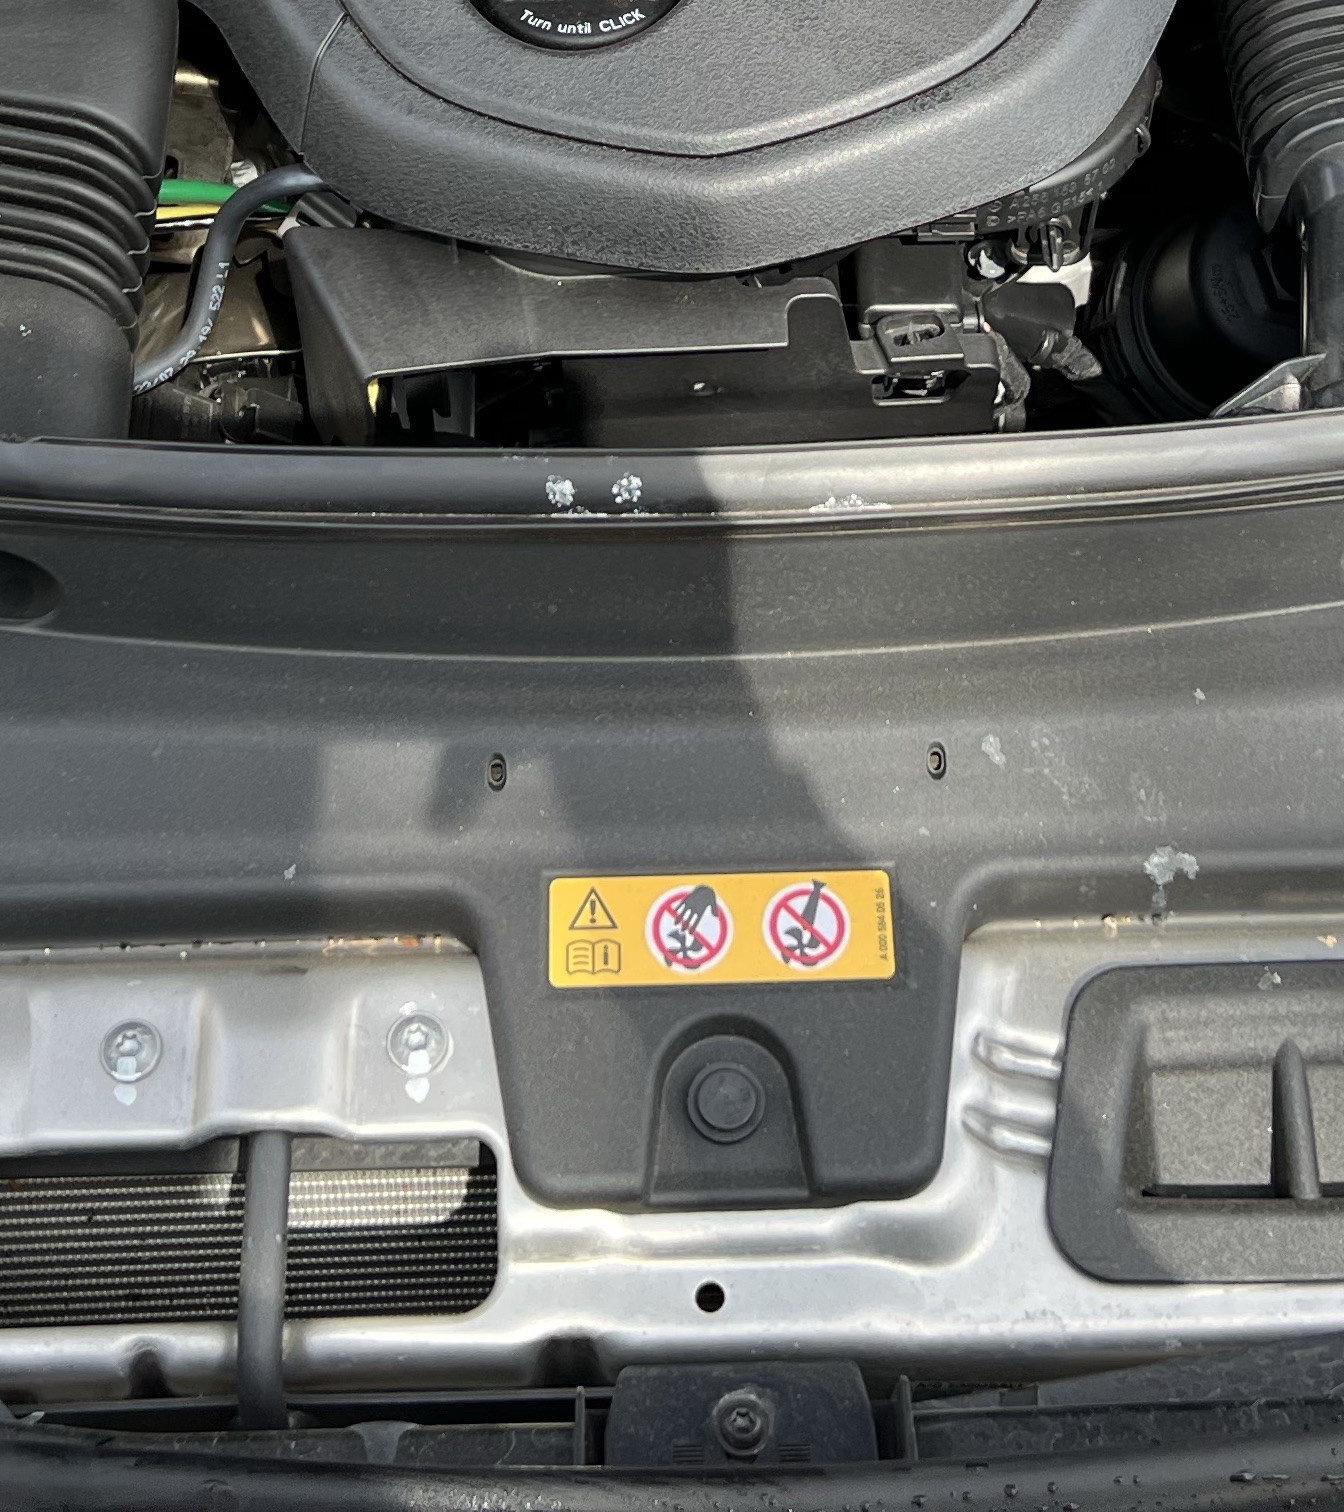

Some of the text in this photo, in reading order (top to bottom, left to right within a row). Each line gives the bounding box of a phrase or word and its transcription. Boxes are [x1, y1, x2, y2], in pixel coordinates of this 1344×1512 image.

[519, 8, 646, 34] Turn until CLICK
